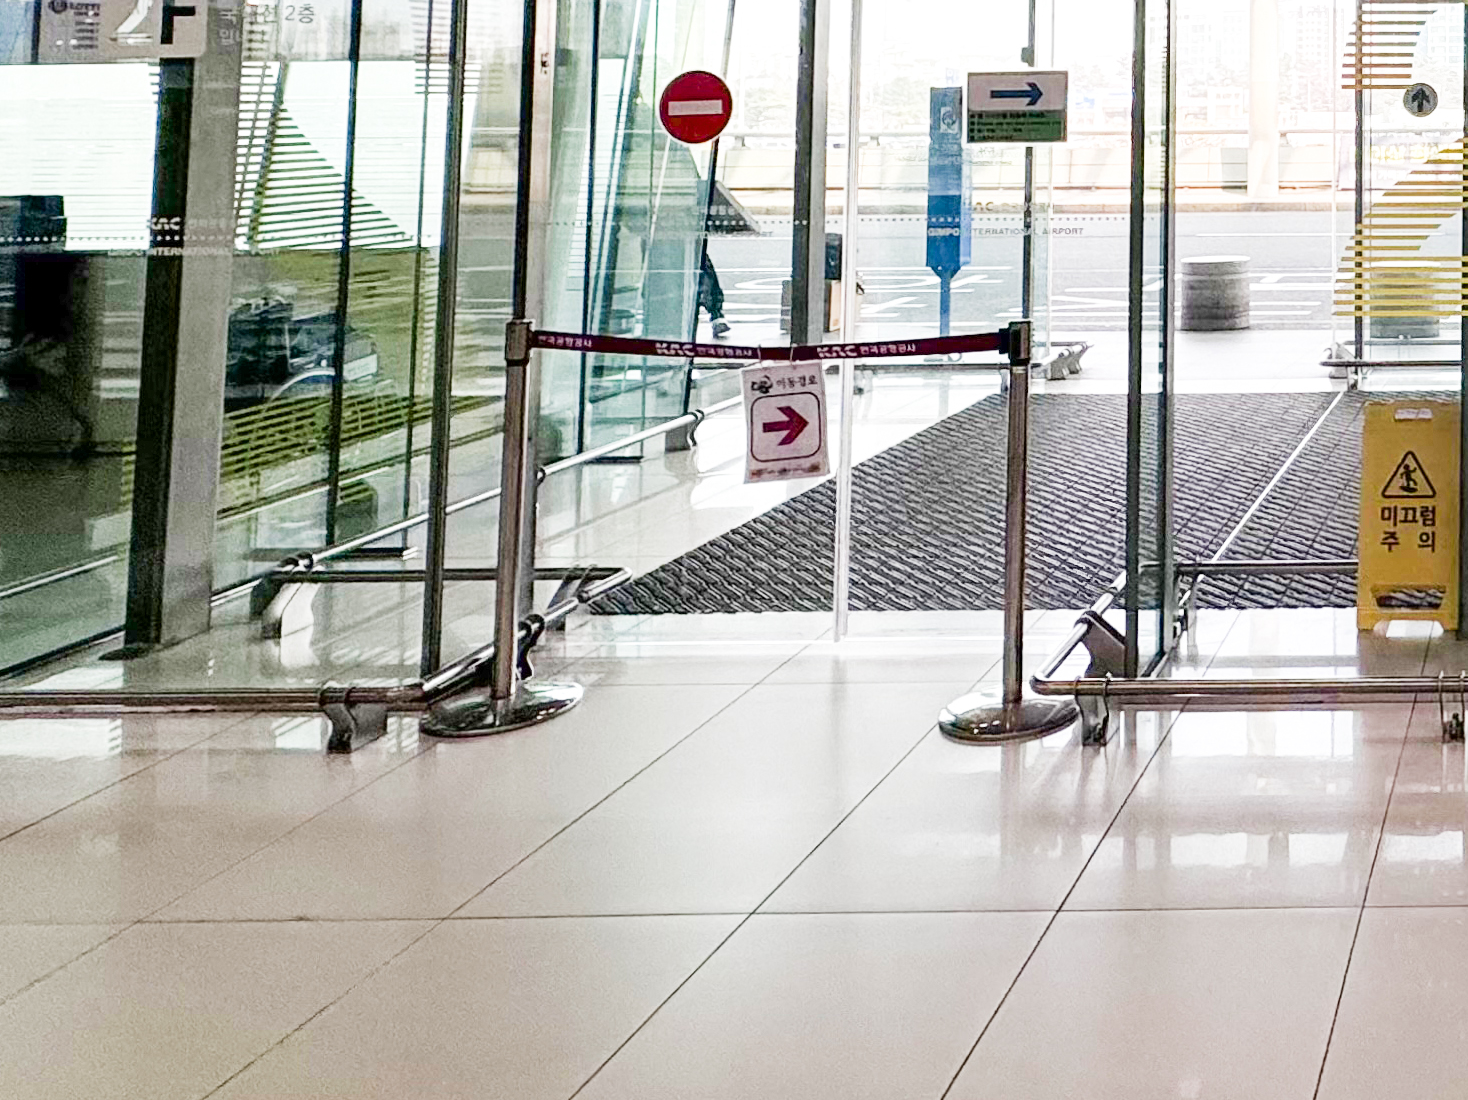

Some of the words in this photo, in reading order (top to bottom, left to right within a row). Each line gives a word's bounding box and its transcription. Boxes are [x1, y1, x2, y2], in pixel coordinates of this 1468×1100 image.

[285, 3, 316, 25] 2층
[816, 344, 858, 359] KAC
[1380, 504, 1437, 528] 미끄럼
